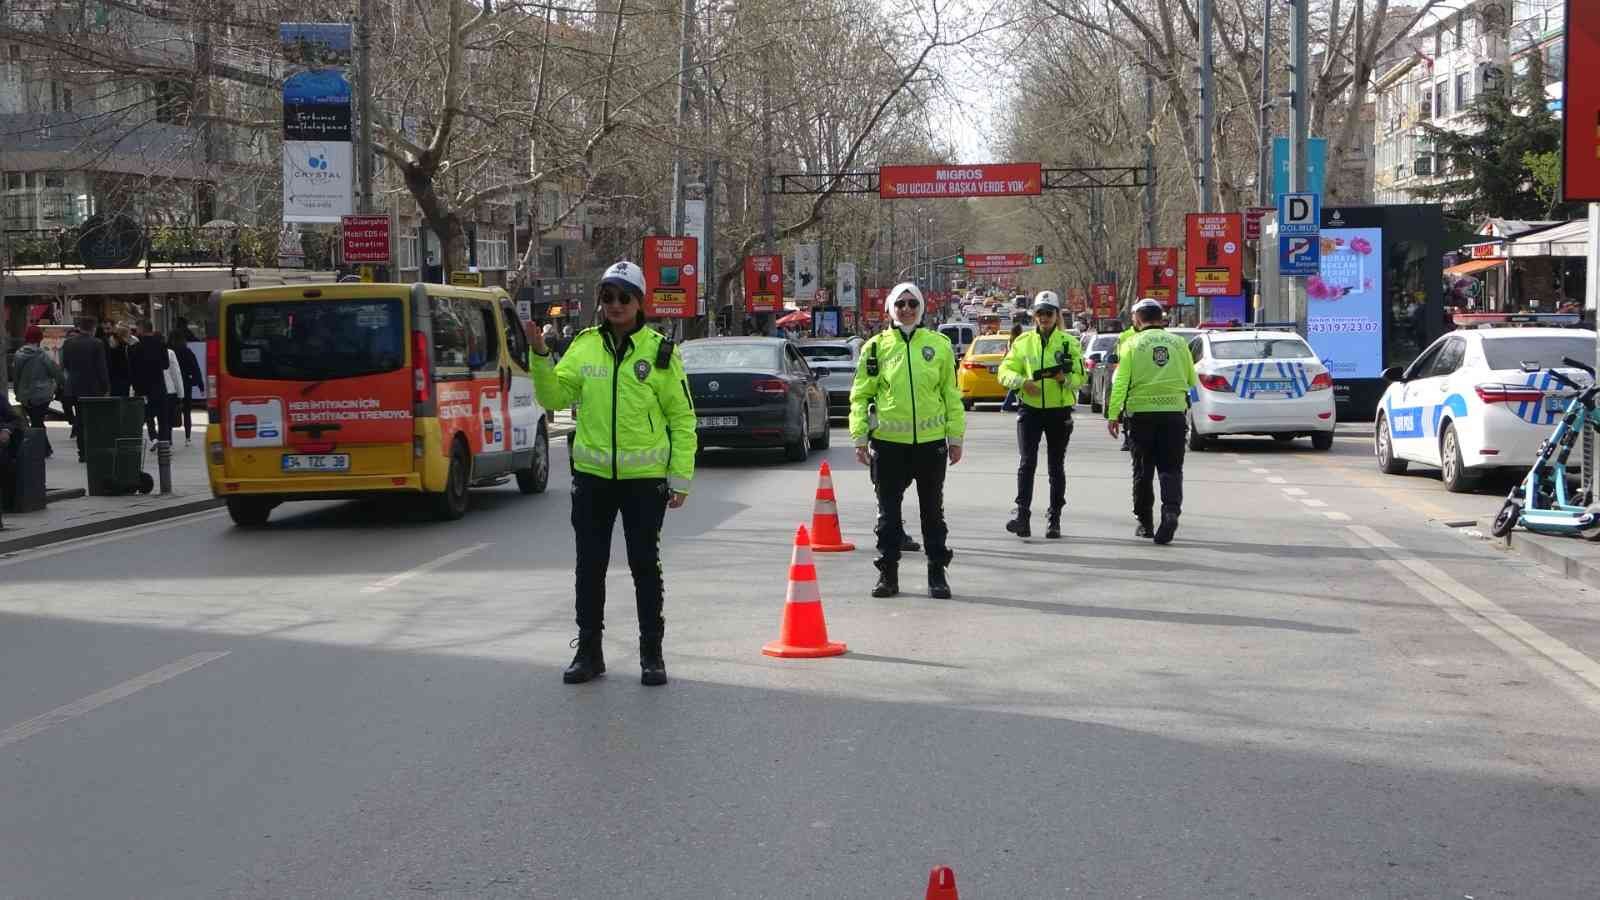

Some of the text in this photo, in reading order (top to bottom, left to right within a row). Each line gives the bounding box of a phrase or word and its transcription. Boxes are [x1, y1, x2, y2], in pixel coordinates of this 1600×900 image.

[936, 169, 983, 180] MIGROS
[896, 180, 1024, 196] BU UCUZLUK BAŞKA YERDE YOK
[1289, 198, 1309, 221] D
[288, 401, 308, 411] HER
[289, 412, 310, 422] TEK
[360, 409, 413, 420] TRENDYOL
[289, 456, 301, 467] 34
